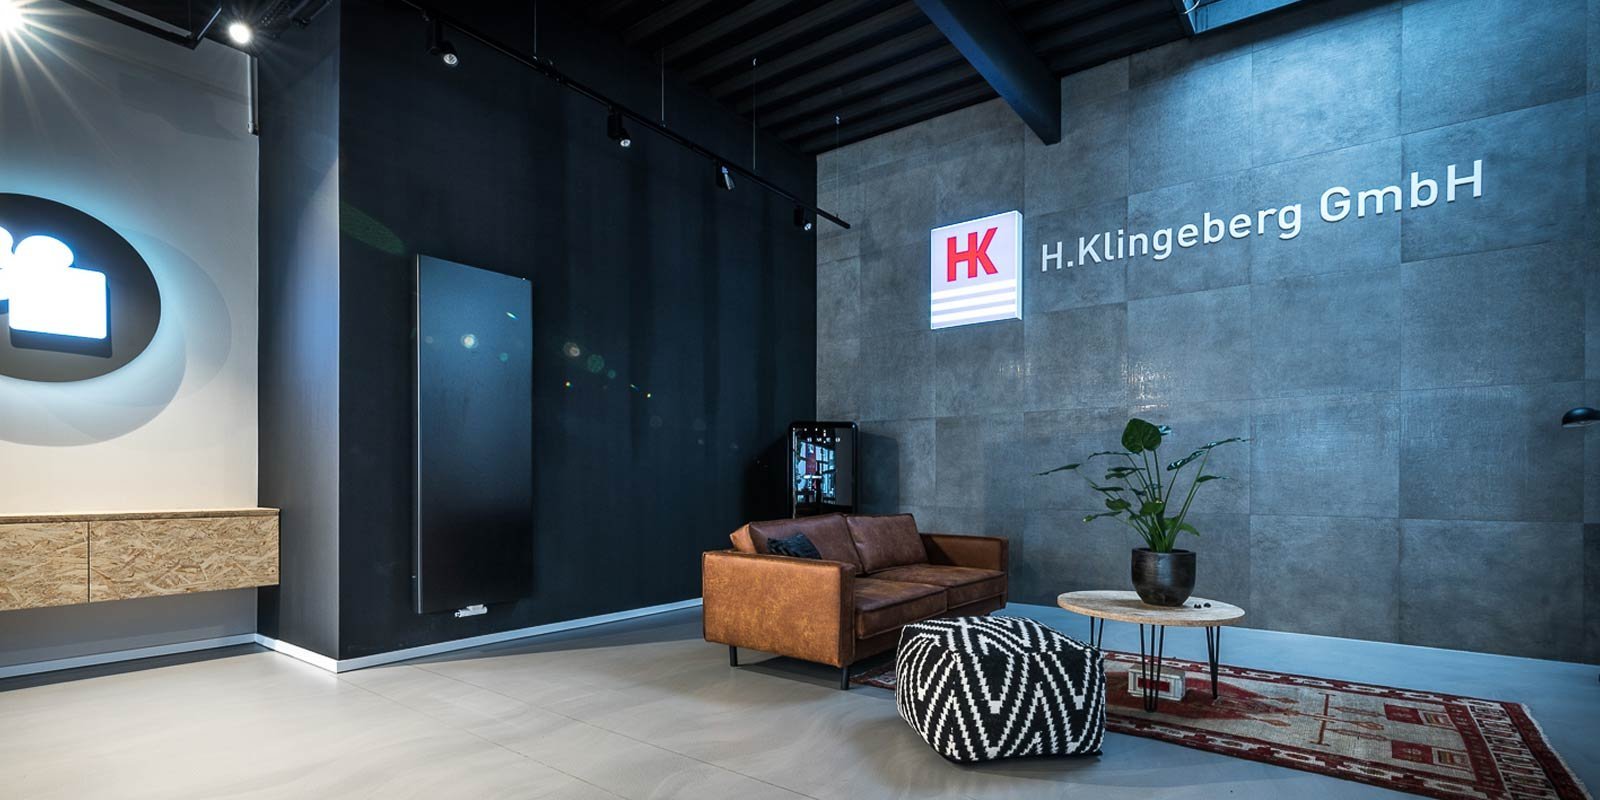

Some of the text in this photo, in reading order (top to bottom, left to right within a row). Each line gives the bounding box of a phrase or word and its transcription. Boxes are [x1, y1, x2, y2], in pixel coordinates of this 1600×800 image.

[947, 227, 998, 282] HK
[1041, 159, 1482, 272] H.Klingeberg GmbH
